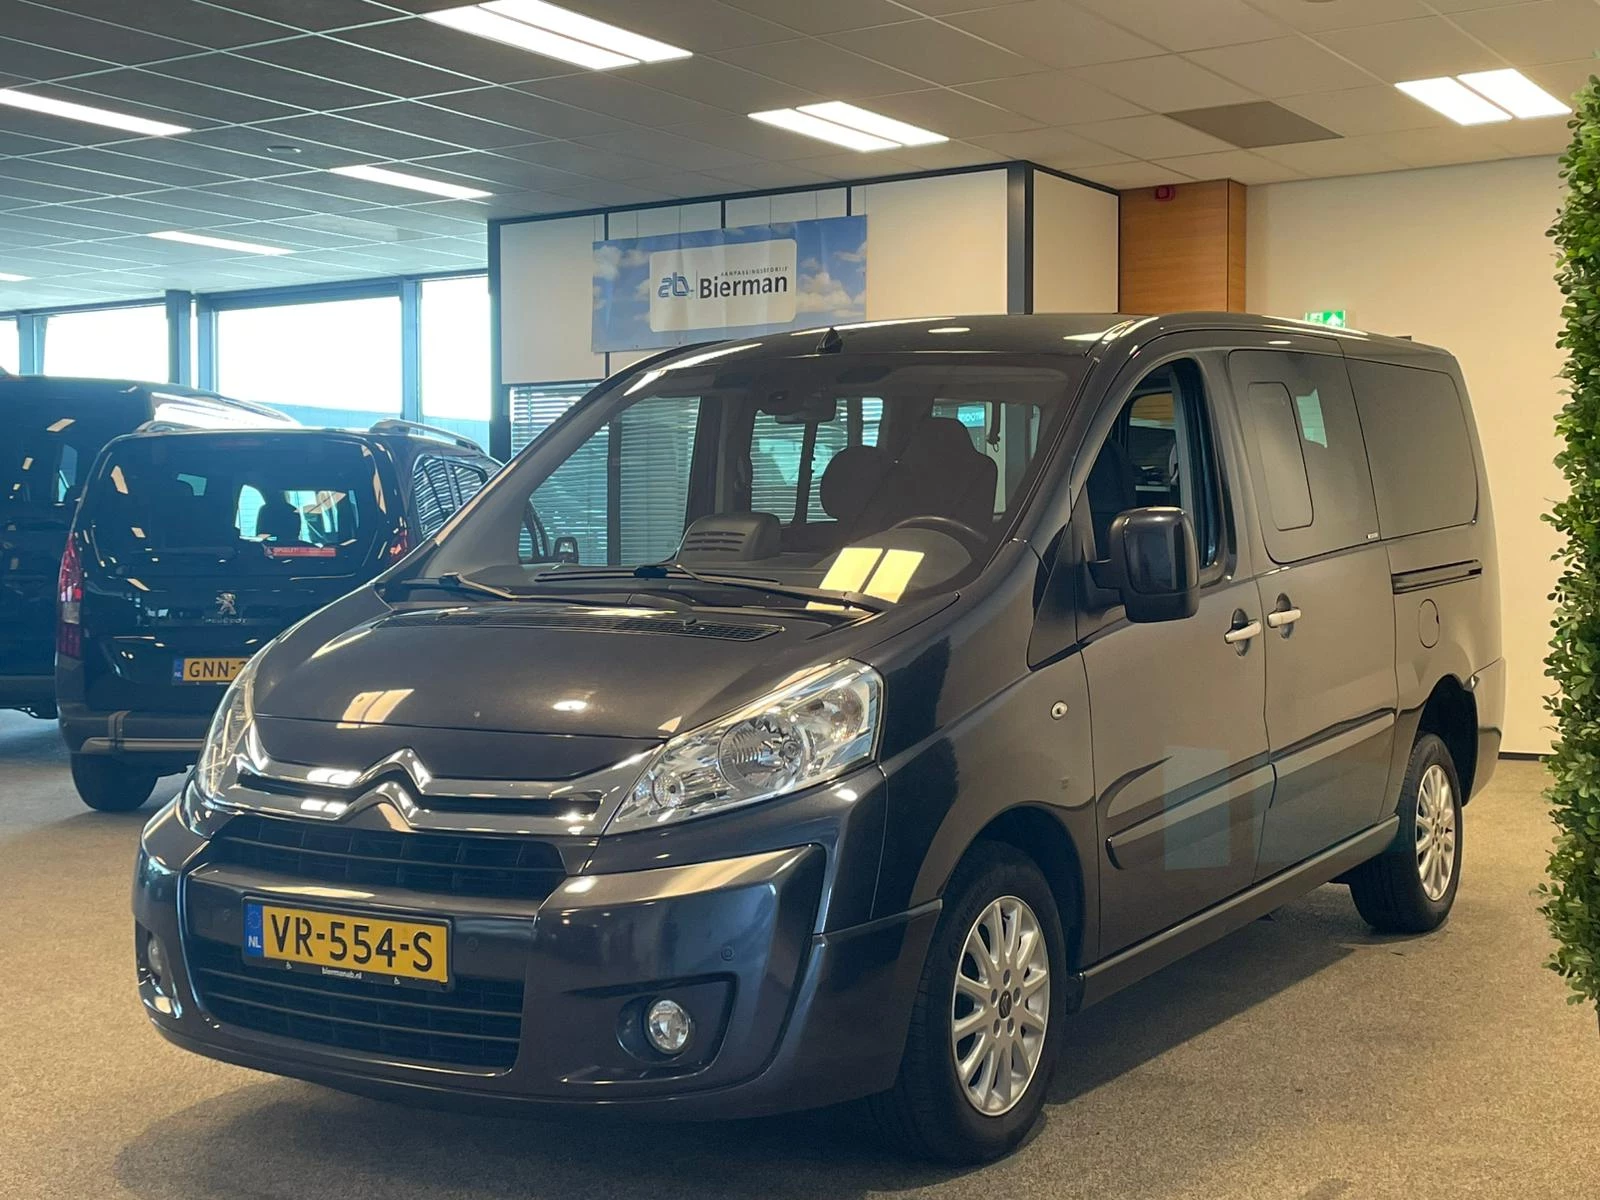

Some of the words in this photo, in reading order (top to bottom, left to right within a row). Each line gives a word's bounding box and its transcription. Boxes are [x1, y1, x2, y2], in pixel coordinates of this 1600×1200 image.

[699, 275, 788, 299] Bierman
[248, 935, 262, 949] NL
[270, 913, 433, 973] VR-554-S
